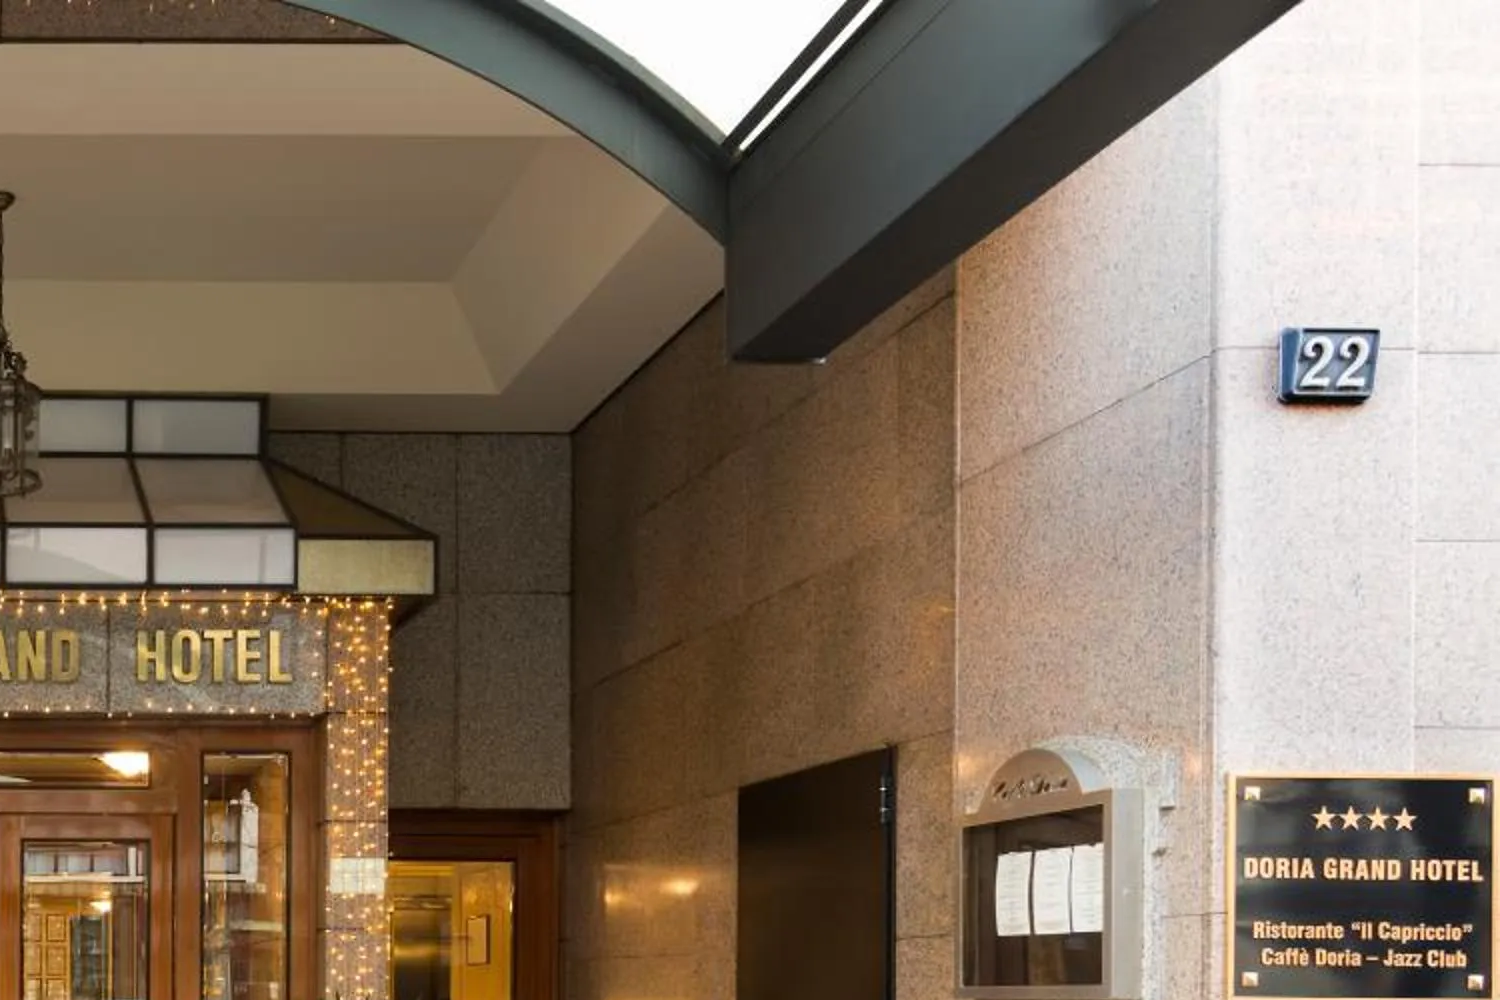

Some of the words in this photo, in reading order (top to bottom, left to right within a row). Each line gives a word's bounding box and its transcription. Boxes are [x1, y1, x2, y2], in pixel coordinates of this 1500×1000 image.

[1299, 334, 1371, 388] 22
[136, 628, 294, 684] HOTEL
[1242, 856, 1316, 880] DORIA
[1323, 857, 1402, 881] GRAND
[1410, 859, 1484, 882] HOTEL
[1252, 919, 1345, 940] Ristorante
[1261, 947, 1310, 967] Caffè
[1315, 947, 1362, 967] Doria
[1383, 948, 1423, 967] Jazz
[1427, 949, 1467, 968] Club
